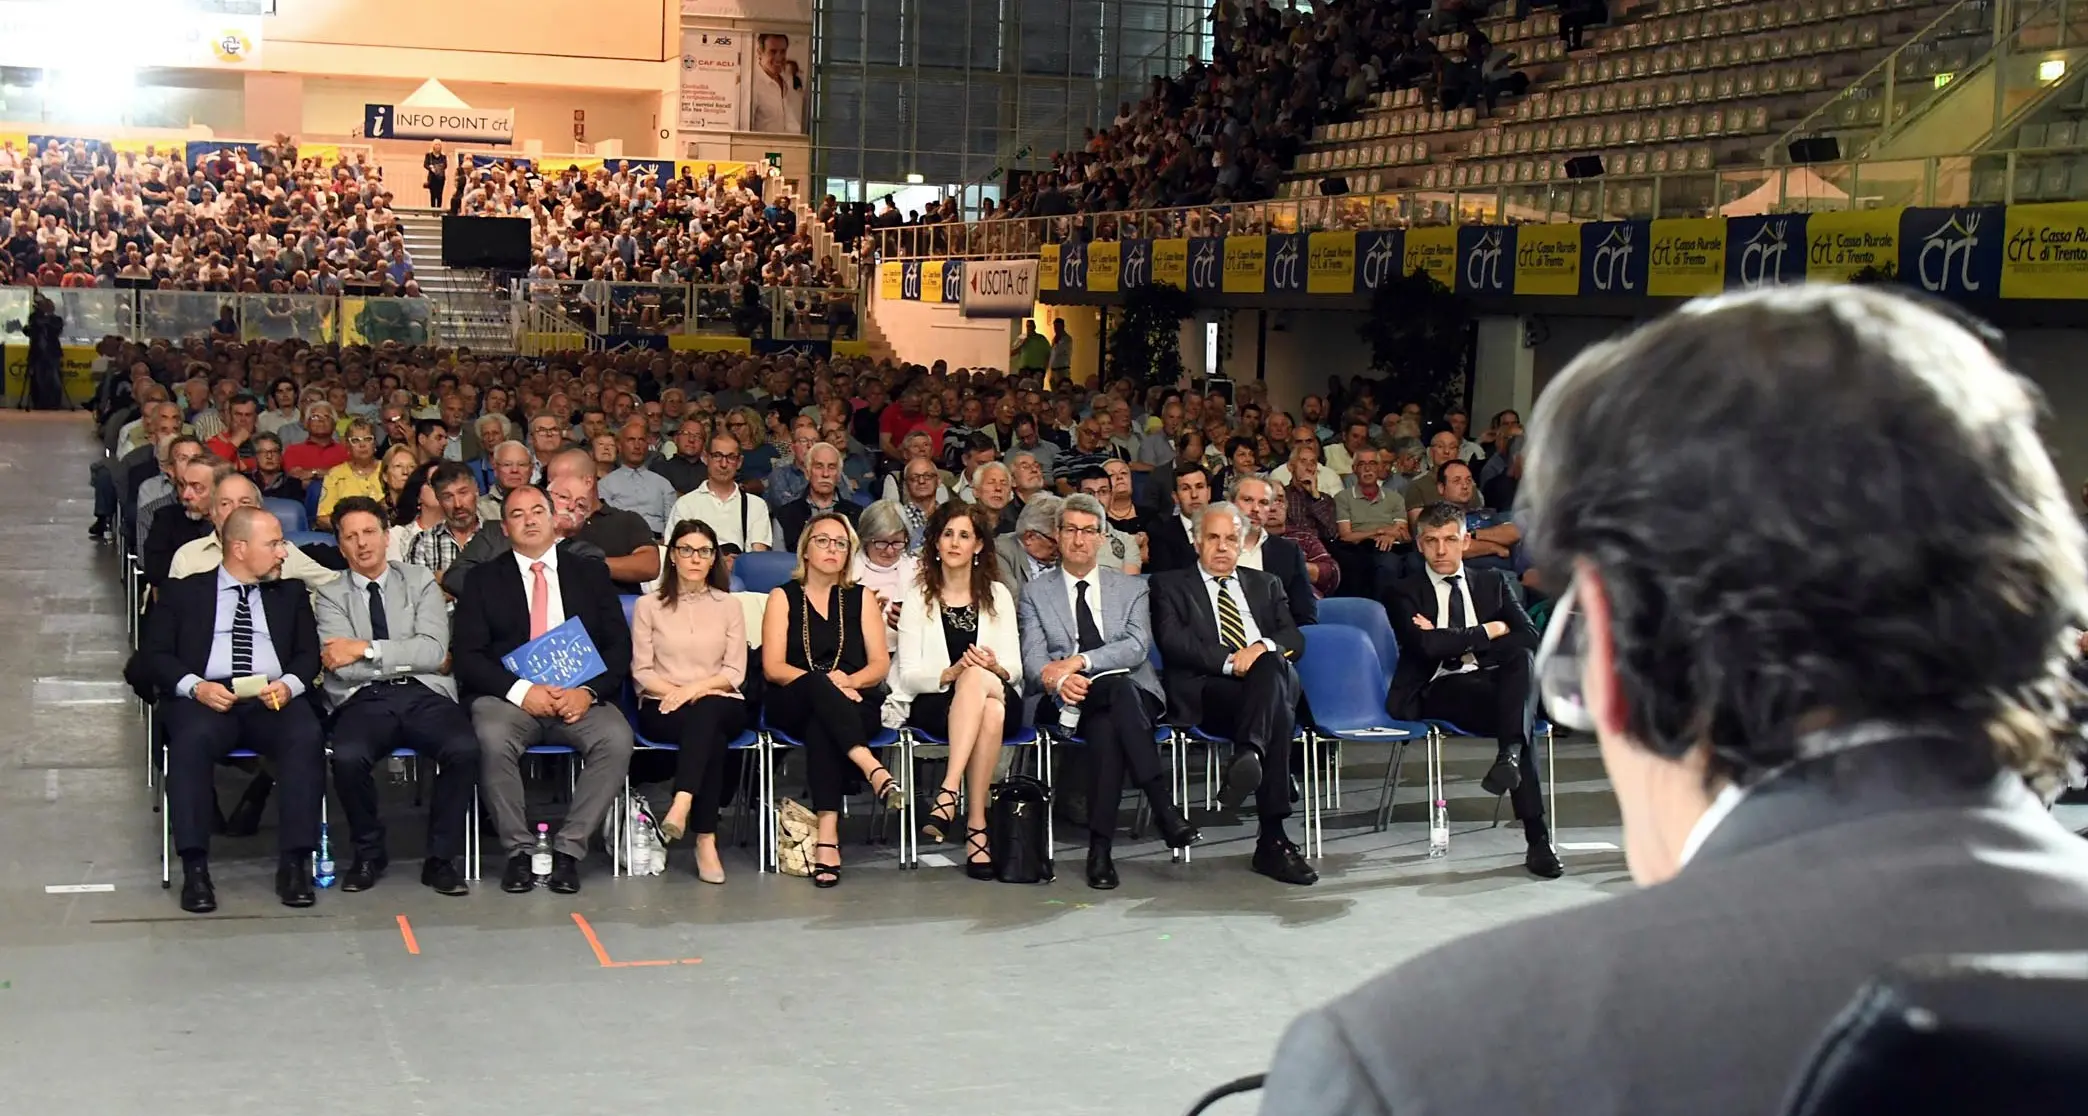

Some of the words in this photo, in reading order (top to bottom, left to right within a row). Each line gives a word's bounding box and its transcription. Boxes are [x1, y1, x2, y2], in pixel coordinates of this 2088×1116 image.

[396, 113, 434, 128] INFO
[439, 116, 488, 131] POINT
[1836, 233, 1861, 248] Cassa
[1863, 232, 1893, 248] Rurale
[2040, 226, 2072, 243] Cassa
[1674, 237, 1695, 251] Cassa
[1698, 237, 1722, 250] Rurale
[1593, 233, 1634, 290] crt
[1682, 252, 1706, 265] Trento
[1846, 249, 1875, 264] Trento
[1918, 217, 1981, 292] crt
[2052, 245, 2088, 262] Trento
[980, 269, 1014, 295] USCITA
